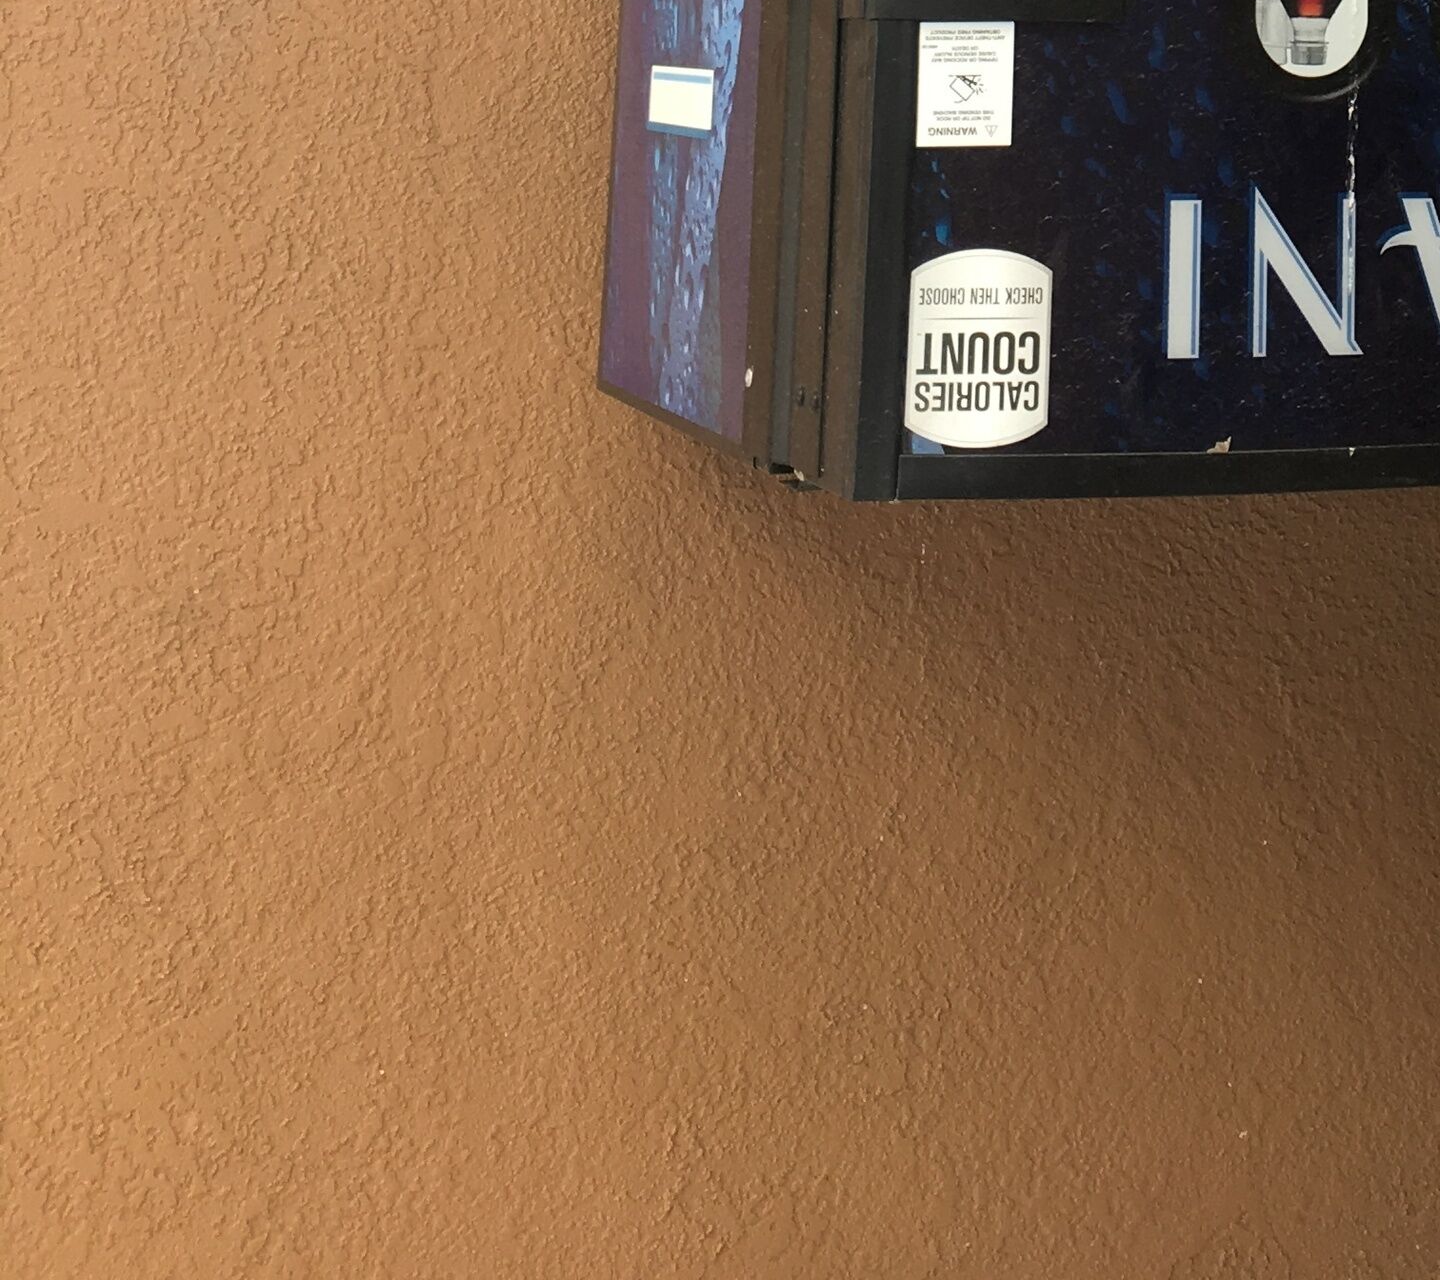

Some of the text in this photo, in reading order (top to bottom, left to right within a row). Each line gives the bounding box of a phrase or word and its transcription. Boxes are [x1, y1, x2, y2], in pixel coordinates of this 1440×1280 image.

[928, 127, 977, 136] WARNING
[918, 287, 1043, 306] CHECK THEN CHOOSE
[916, 331, 1040, 375] COUNT
[914, 381, 1039, 412] CALORIES
